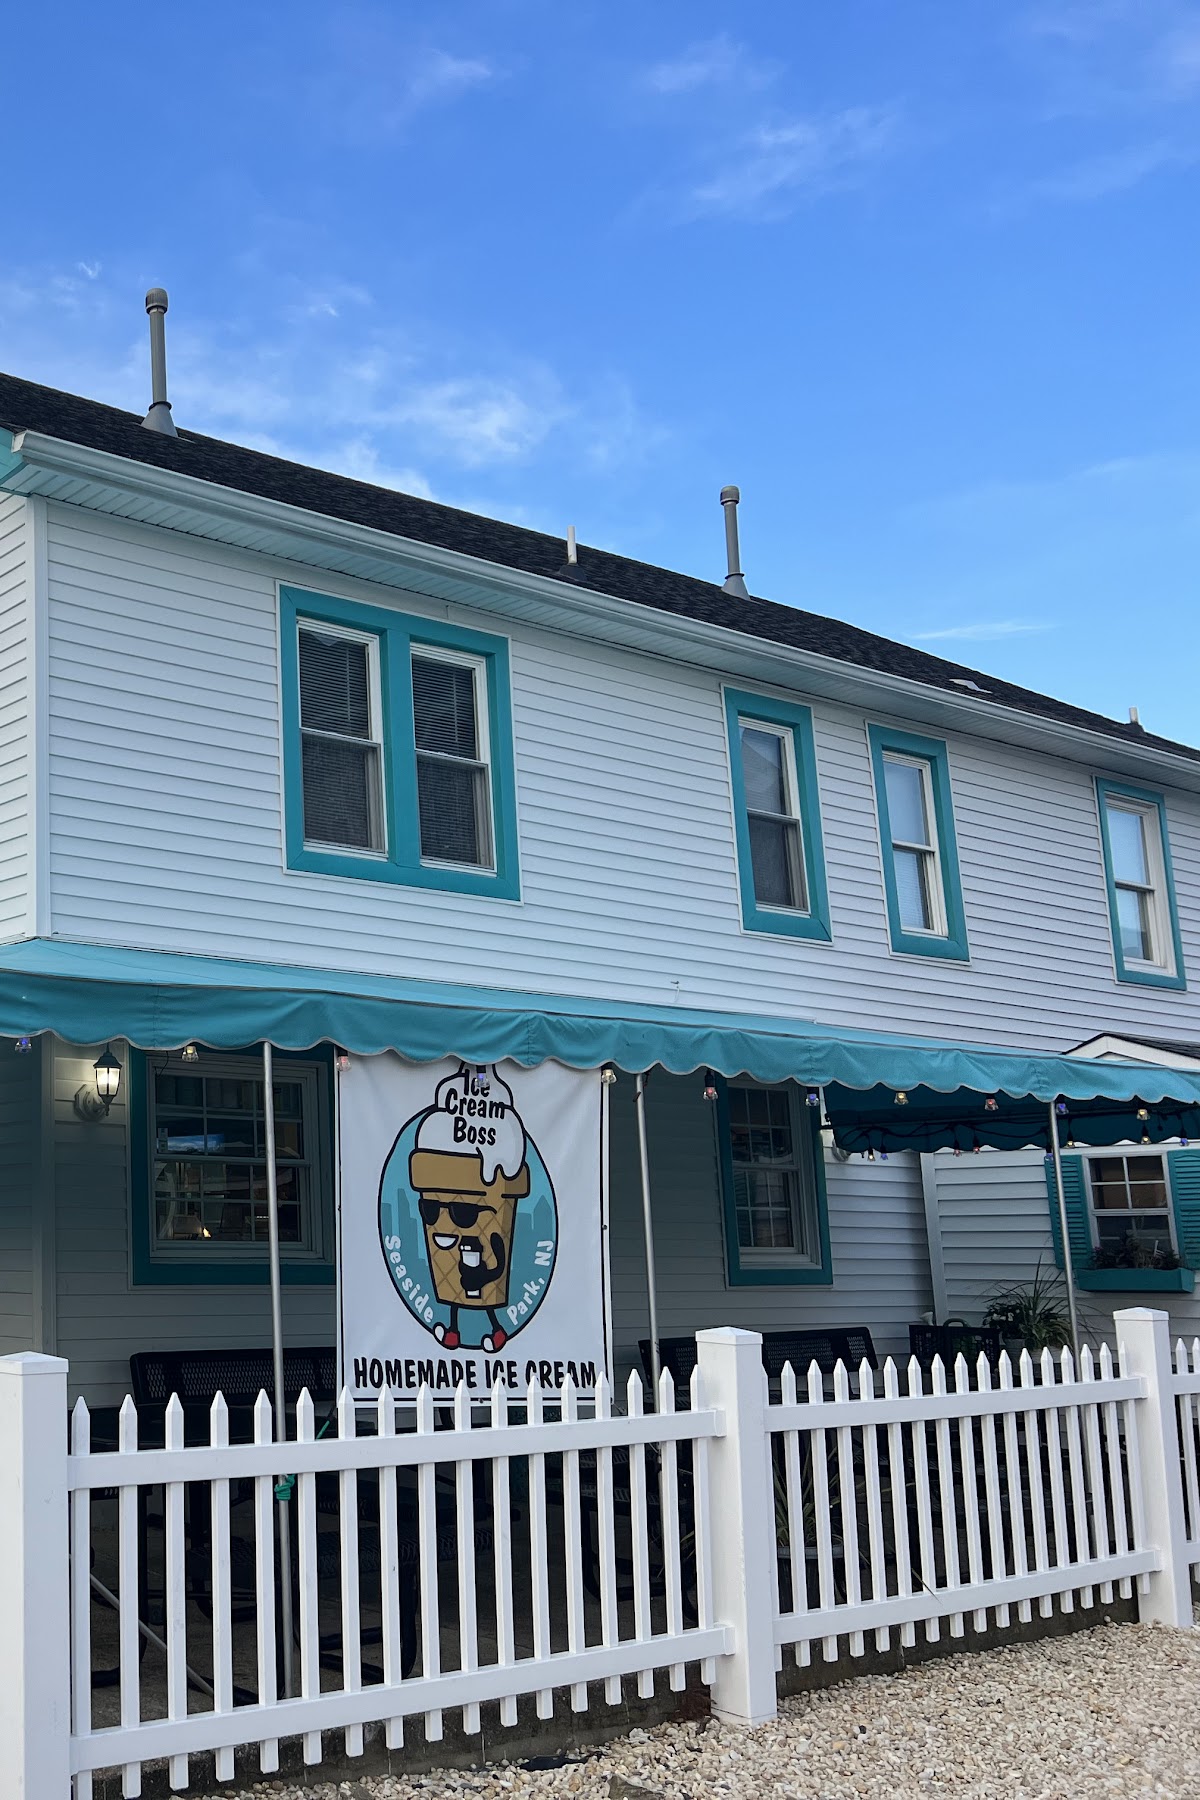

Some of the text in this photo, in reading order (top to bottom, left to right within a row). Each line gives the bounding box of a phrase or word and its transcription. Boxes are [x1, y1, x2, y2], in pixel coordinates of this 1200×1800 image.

[445, 1087, 505, 1120] Cream
[453, 1116, 496, 1146] Boss
[384, 1235, 434, 1323] Seaside
[506, 1240, 554, 1326] Park, NJ
[353, 1357, 597, 1390] HOMEMADE ICE CREAM
